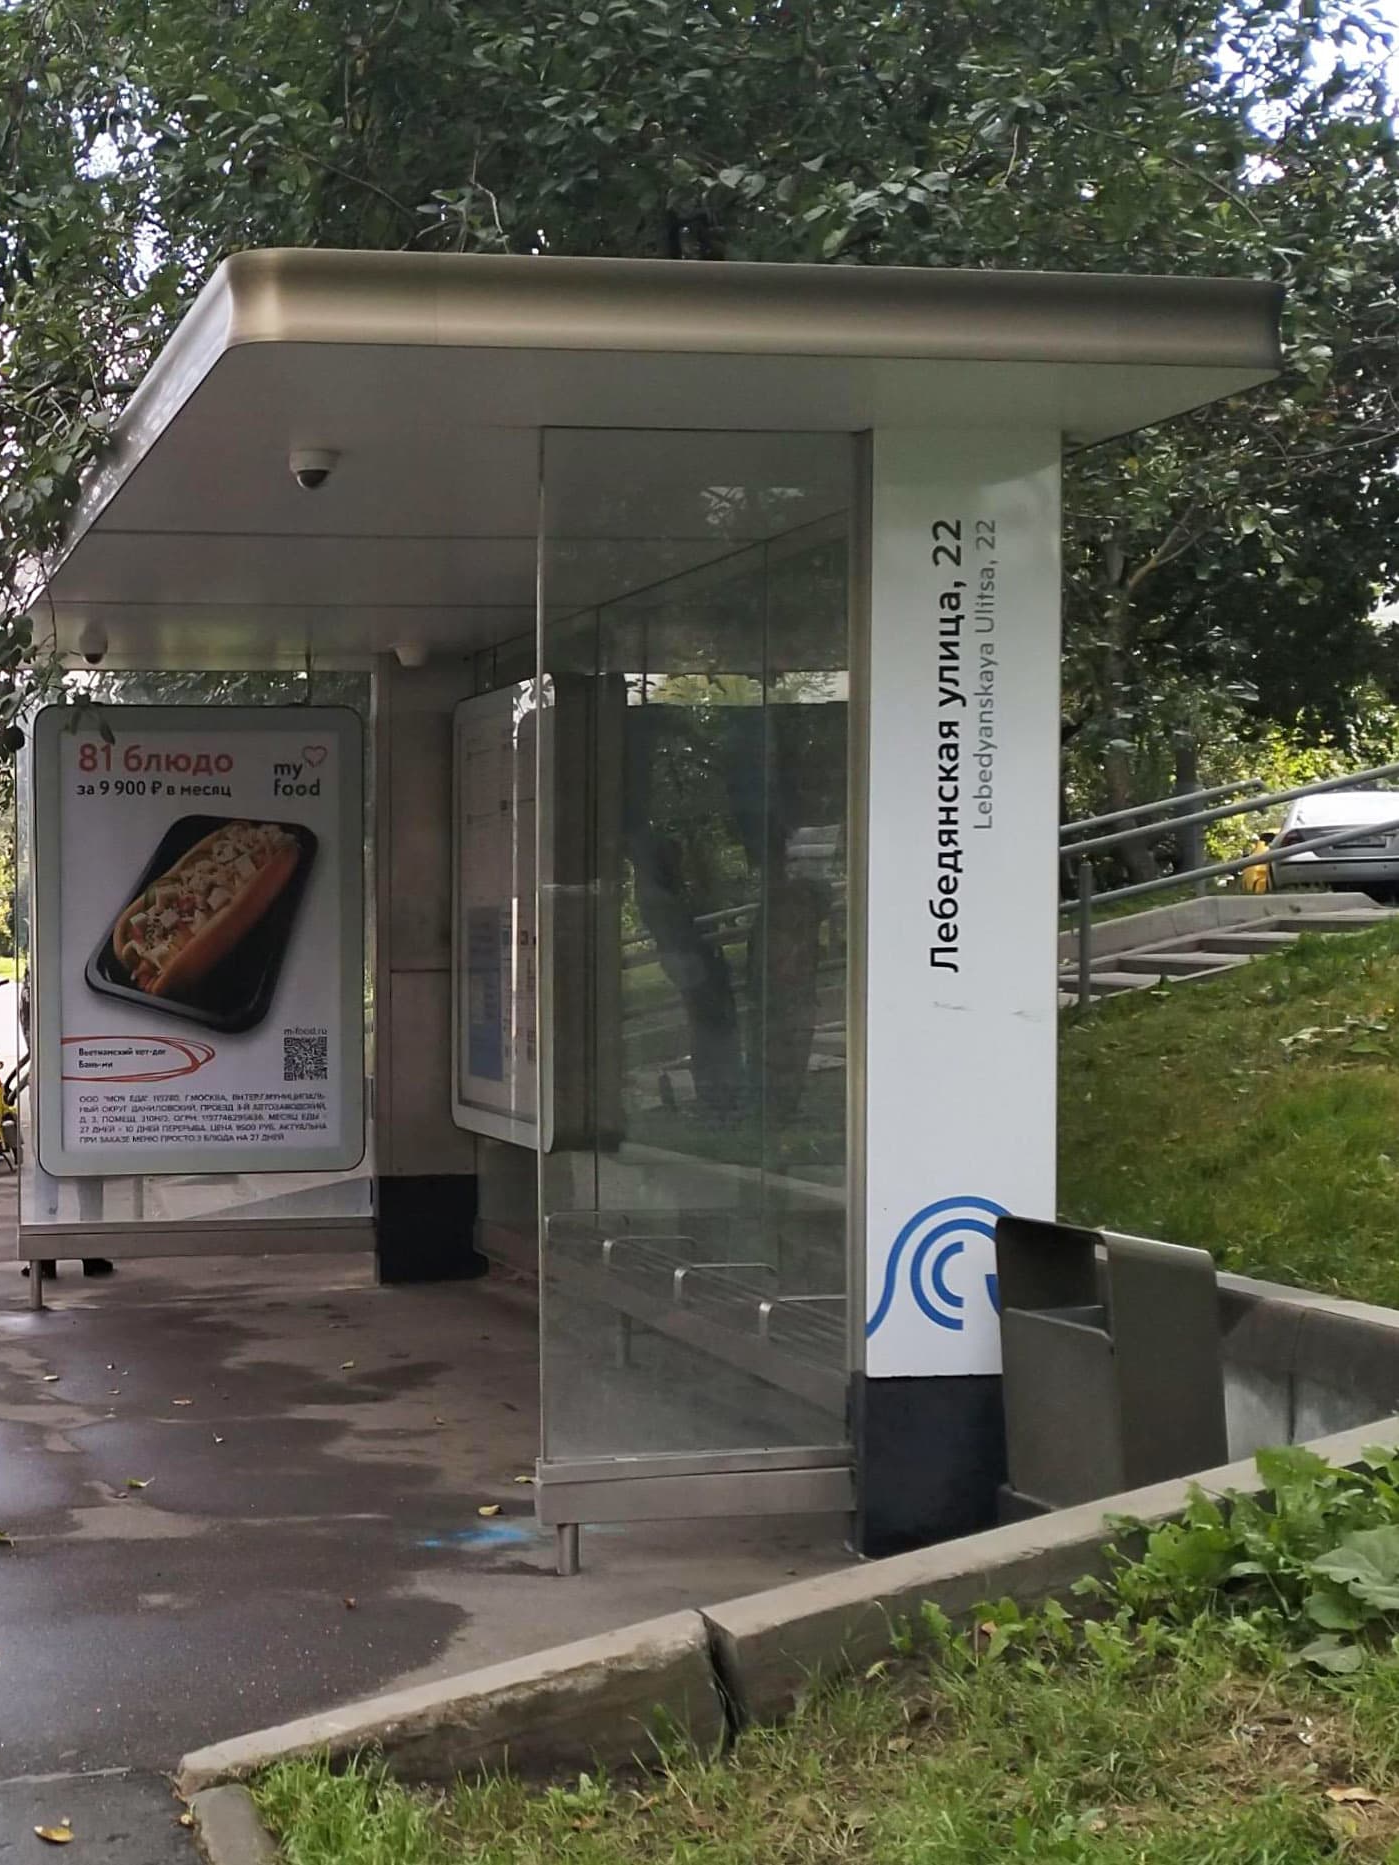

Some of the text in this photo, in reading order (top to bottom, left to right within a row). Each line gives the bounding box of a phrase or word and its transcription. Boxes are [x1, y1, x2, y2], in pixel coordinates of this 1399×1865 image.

[972, 519, 999, 830] Lebedyanskaya Ulitsa, 22
[929, 519, 967, 973] Лебедянская улица, 22
[78, 744, 234, 775] 81 блюдо
[274, 762, 302, 778] my
[76, 784, 95, 796] за
[99, 781, 109, 795] 9
[115, 781, 146, 795] 900
[167, 785, 175, 796] в
[180, 785, 231, 797] месяц
[273, 779, 320, 796] food
